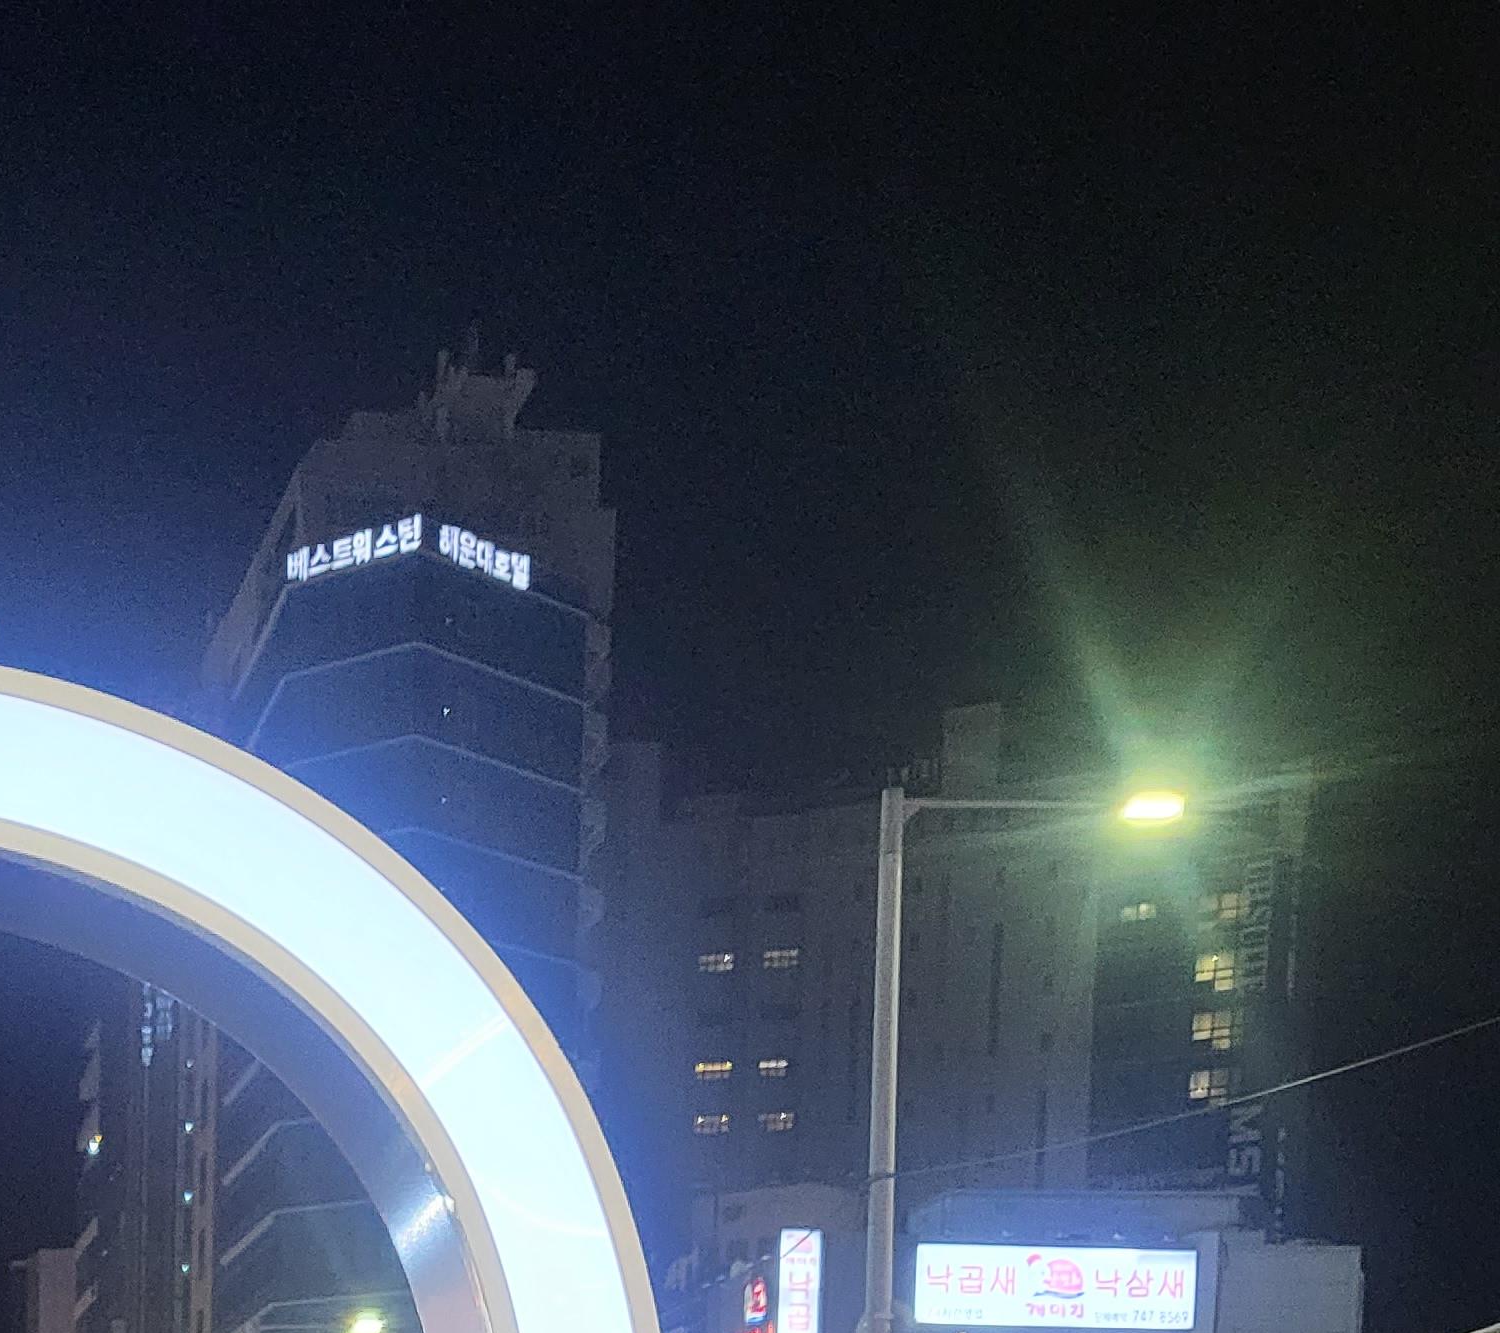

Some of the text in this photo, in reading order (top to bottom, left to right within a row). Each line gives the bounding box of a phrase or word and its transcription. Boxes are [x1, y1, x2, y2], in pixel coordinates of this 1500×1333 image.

[286, 513, 531, 591] 베스트웨스턴 해운대호텔
[927, 1264, 1016, 1295] 낙곱새
[1094, 1269, 1185, 1298] 낙삼새
[1132, 1309, 1154, 1323] 747
